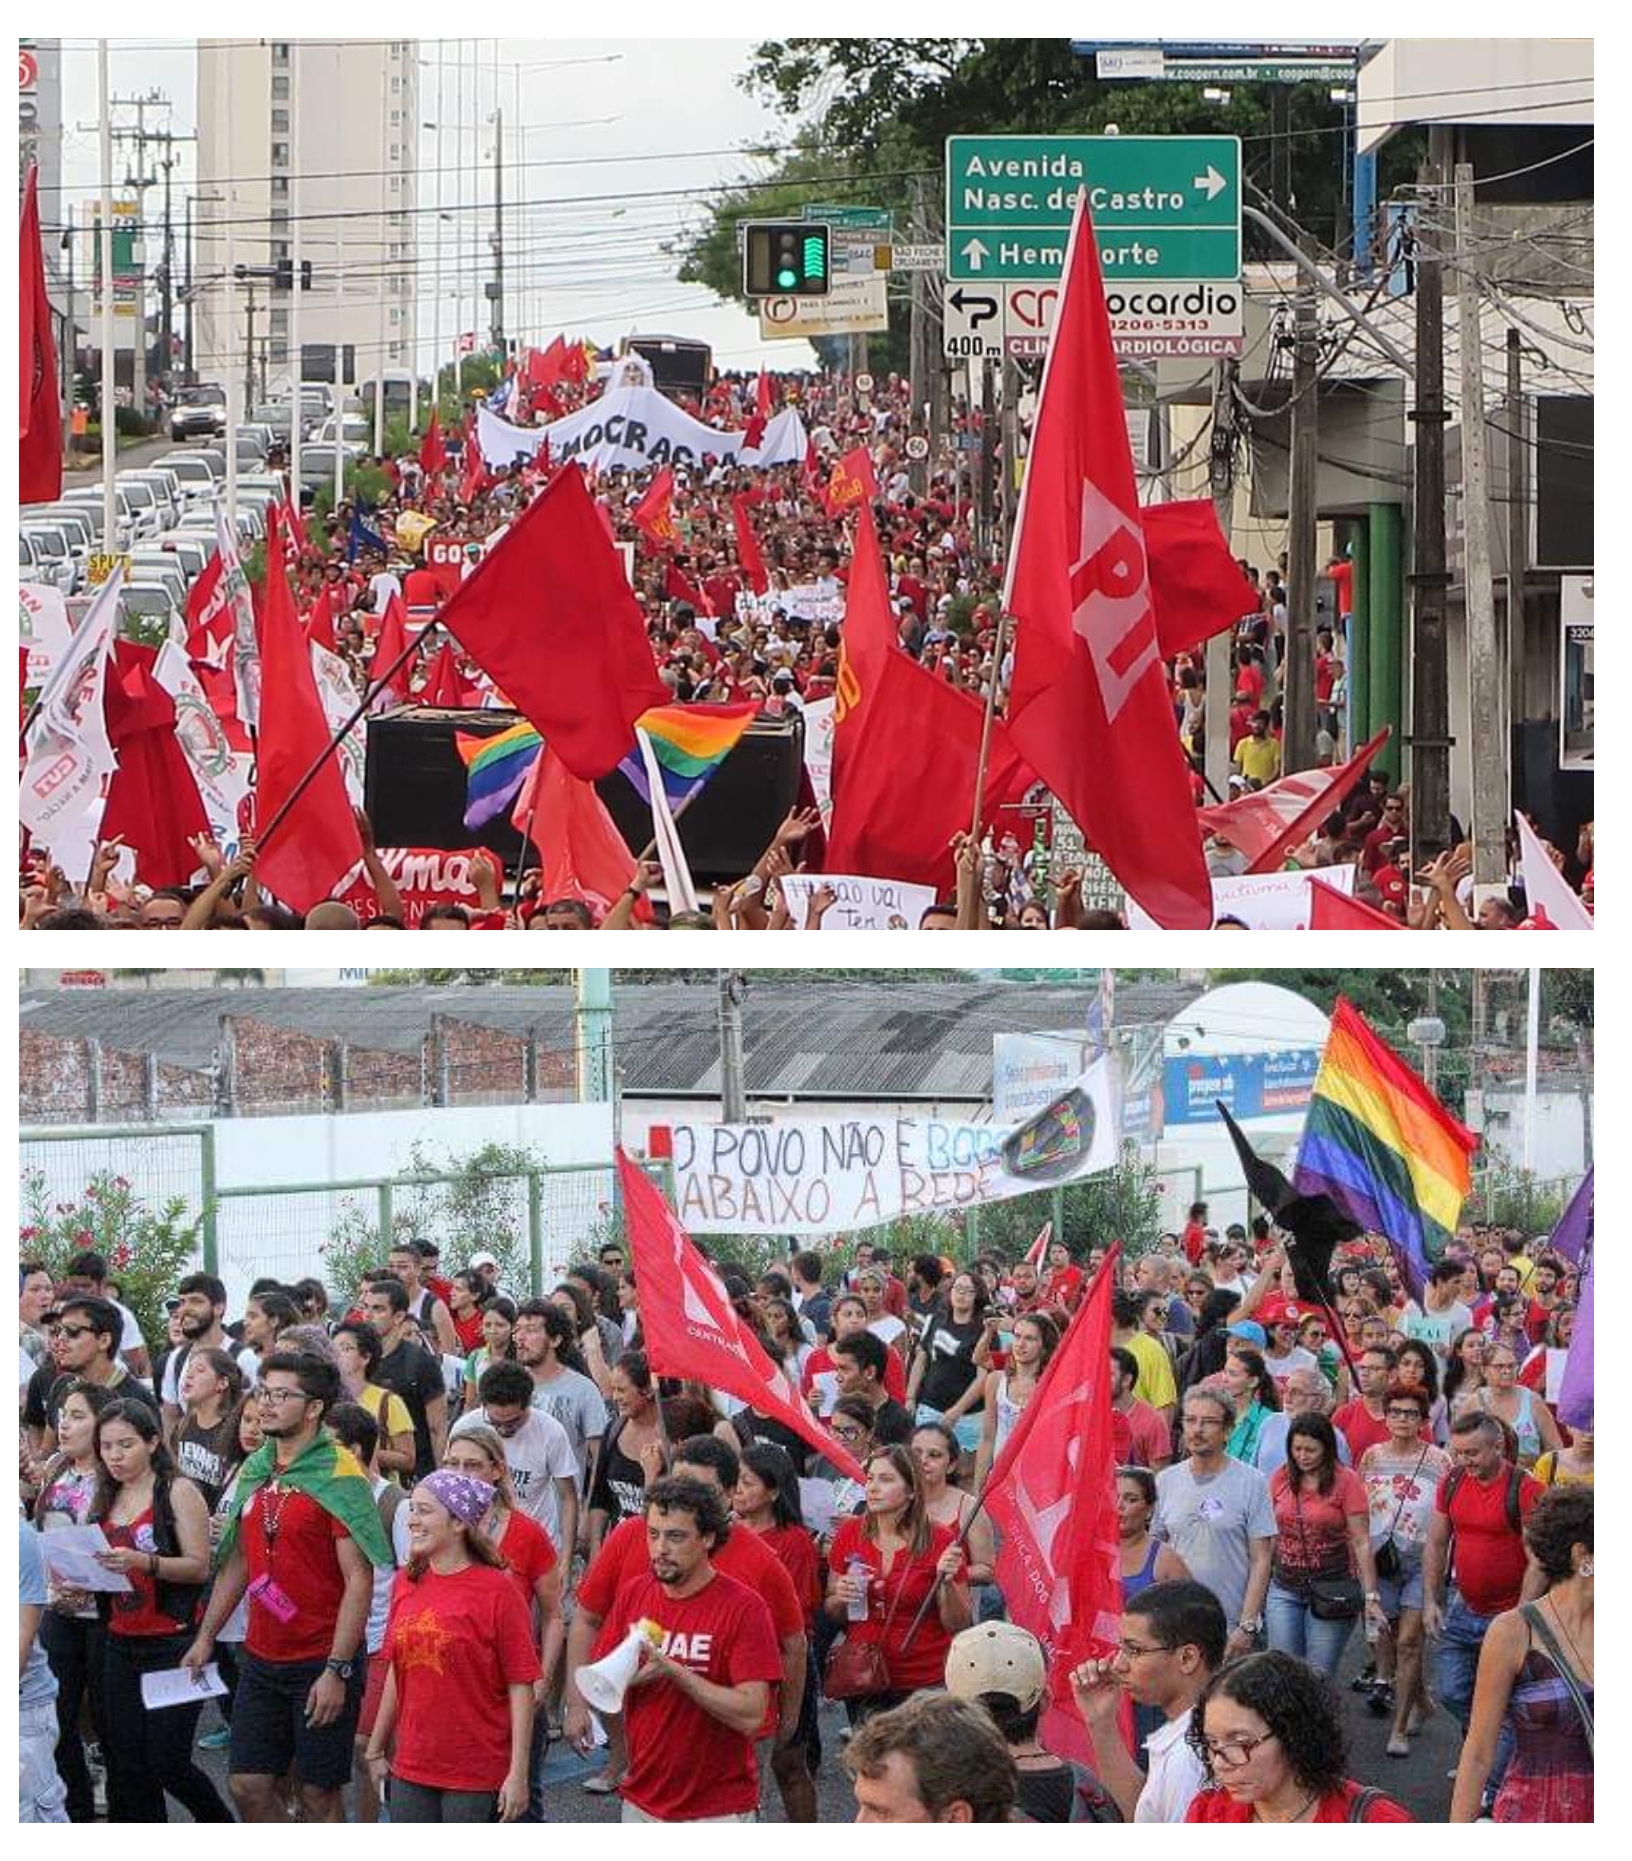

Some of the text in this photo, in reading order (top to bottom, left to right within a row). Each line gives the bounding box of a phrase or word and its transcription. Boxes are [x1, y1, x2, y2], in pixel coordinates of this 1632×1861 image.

[965, 154, 1084, 178] Avenida
[964, 188, 1184, 210] Nasc. de Castro
[1000, 243, 1160, 265] Hemorte
[947, 336, 1001, 357] 400 m
[712, 1127, 806, 1177] POVO
[822, 1121, 885, 1171] NÃO
[682, 1161, 1000, 1225] ABAIXO A REDE
